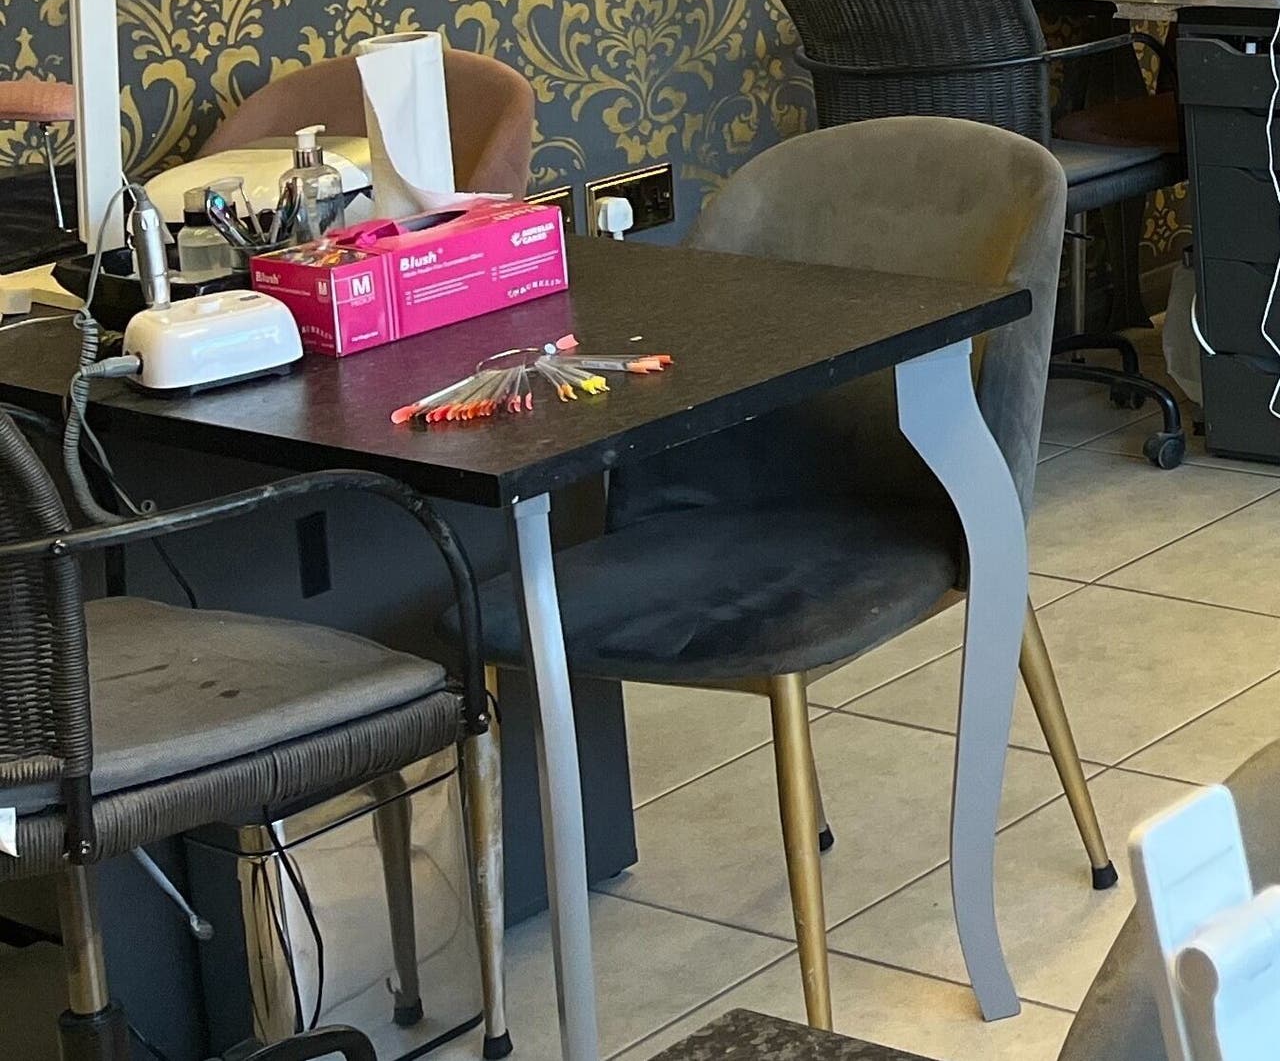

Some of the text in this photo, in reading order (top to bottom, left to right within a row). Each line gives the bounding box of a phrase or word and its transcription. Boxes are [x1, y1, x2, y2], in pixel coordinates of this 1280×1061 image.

[401, 251, 437, 272] Blush
[318, 282, 328, 295] M
[352, 275, 371, 296] M
